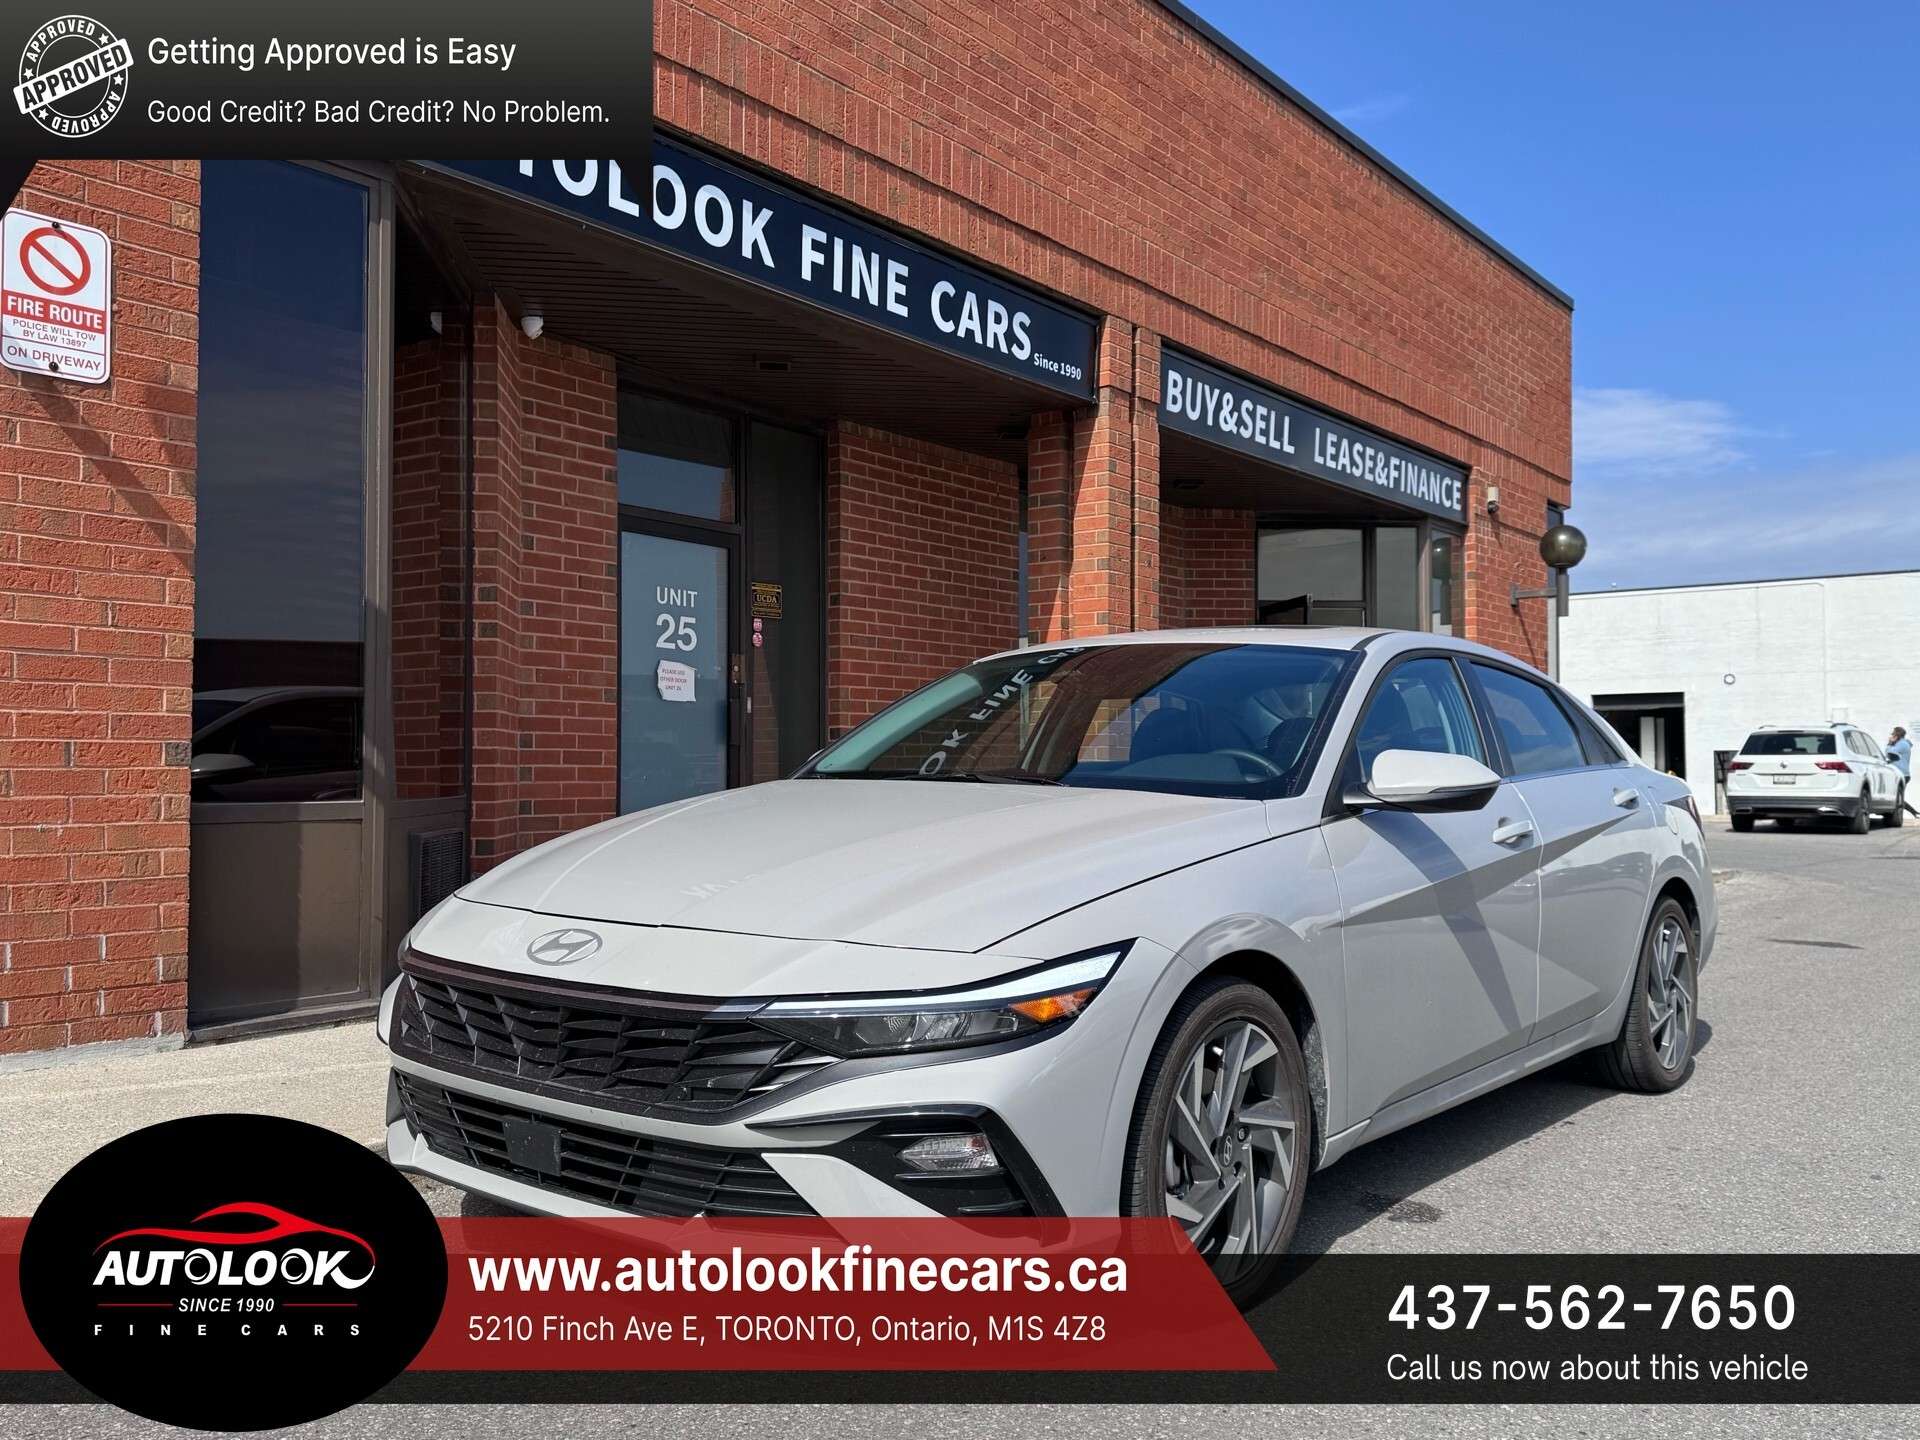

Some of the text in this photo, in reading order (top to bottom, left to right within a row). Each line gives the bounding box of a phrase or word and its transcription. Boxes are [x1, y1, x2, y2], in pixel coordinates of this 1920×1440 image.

[519, 160, 1032, 361] OLOOK FINE CARS
[7, 295, 103, 330] FIRE ROUTE
[13, 318, 97, 342] POLICE WILL TOW
[23, 329, 36, 338] BY
[38, 332, 58, 343] LAW
[7, 345, 101, 371] ON DRIVEWAY
[1033, 352, 1082, 381] Since 1990
[1166, 369, 1462, 511] BUY&SELL LEASE&FINANCE
[656, 586, 698, 609] UNIT
[756, 594, 778, 604] UCDA
[656, 613, 698, 652] 25
